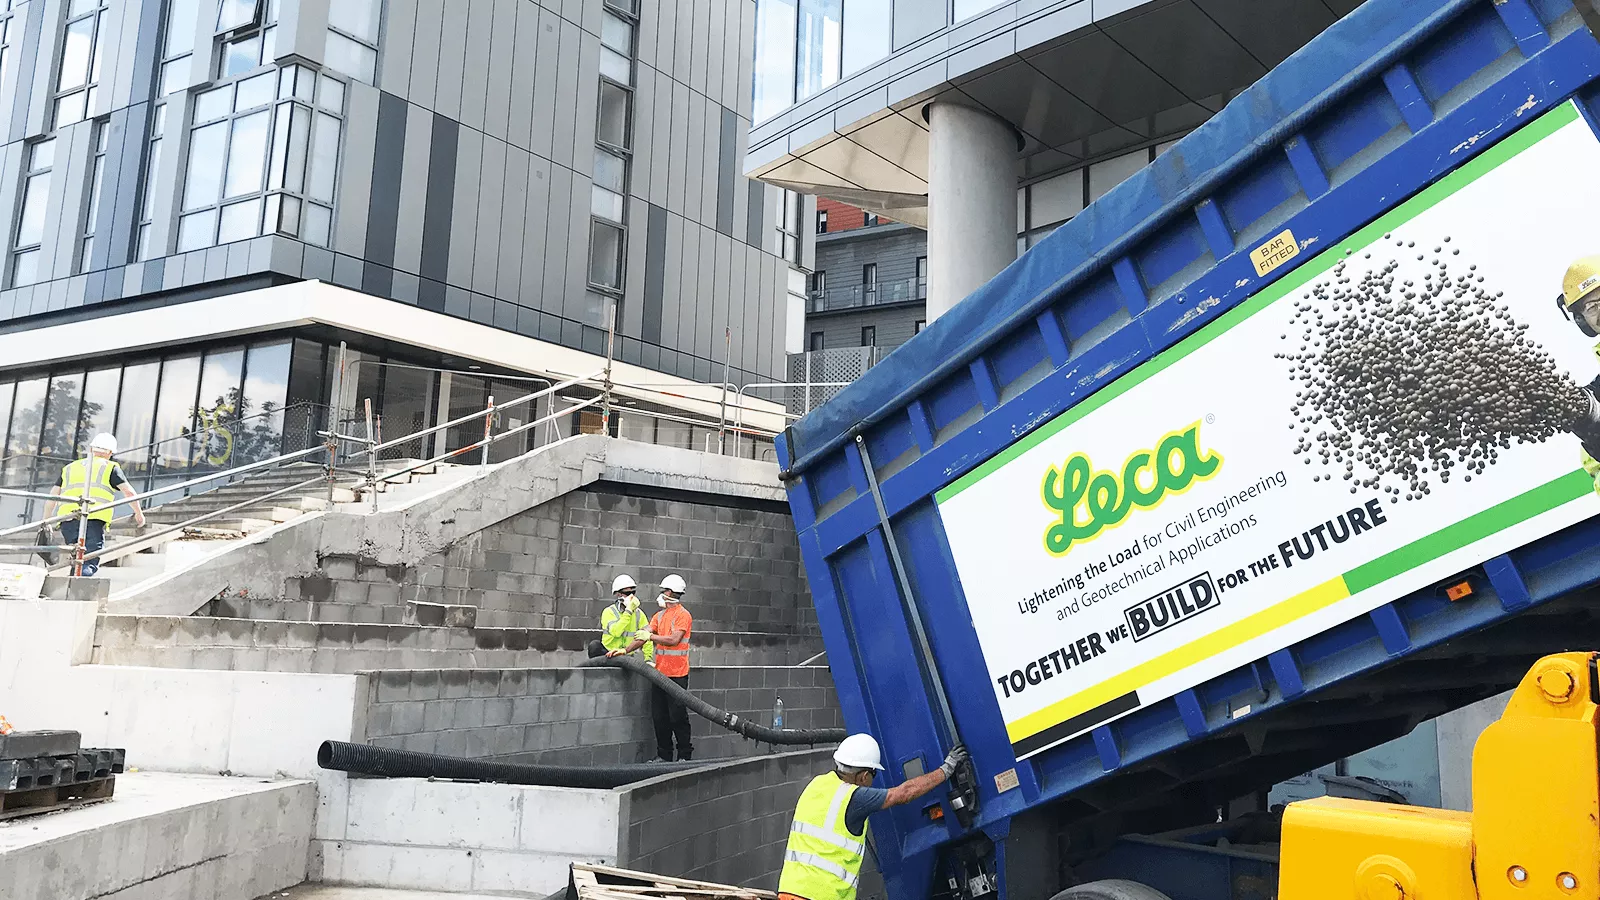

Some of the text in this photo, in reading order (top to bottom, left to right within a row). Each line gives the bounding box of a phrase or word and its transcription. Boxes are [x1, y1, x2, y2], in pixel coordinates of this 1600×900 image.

[1259, 244, 1294, 271] FITTED
[1261, 238, 1284, 257] BAR
[1018, 470, 1287, 614] Lightening the Load for Civil Engineering
[1042, 422, 1222, 555] Leca
[997, 497, 1387, 698] TOGETHER WE BUILD FOR THE FUTURE
[1056, 514, 1257, 621] and Geotechnical Applications
